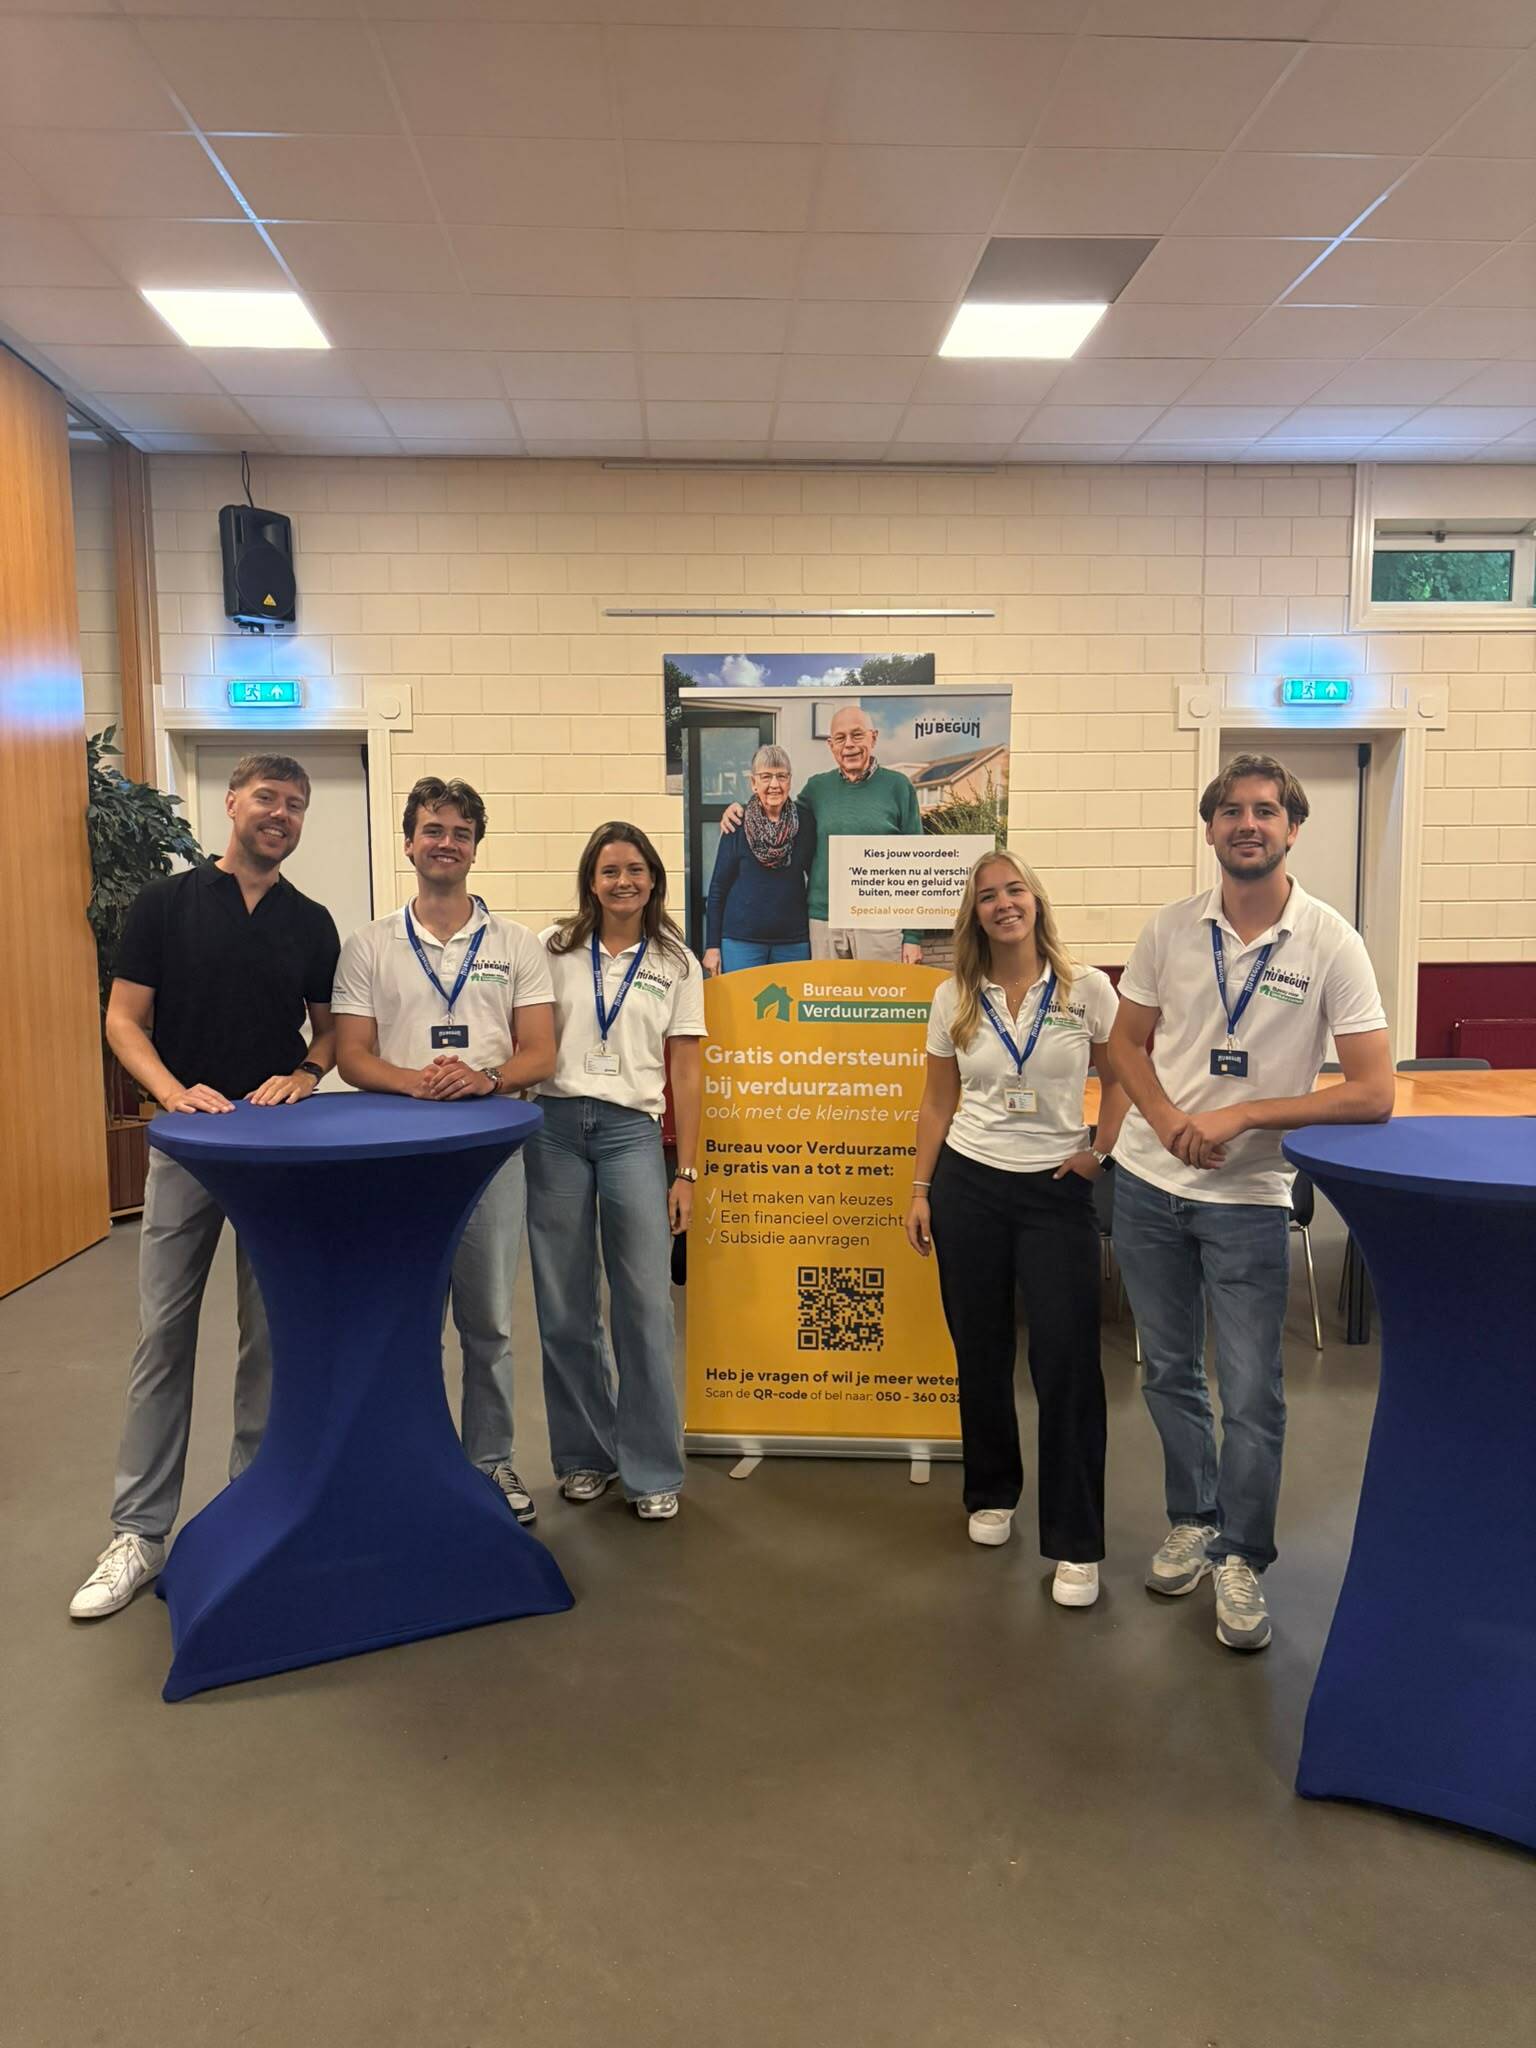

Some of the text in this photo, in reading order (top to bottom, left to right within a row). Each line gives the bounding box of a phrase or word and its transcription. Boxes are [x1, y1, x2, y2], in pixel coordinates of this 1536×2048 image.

[864, 849, 960, 860] Kies jouw voordeel:
[870, 867, 906, 876] merken
[923, 867, 932, 876] al
[851, 878, 885, 886] minder
[887, 878, 905, 886] kou
[922, 878, 952, 888] geluid
[858, 888, 893, 898] buiten,
[850, 906, 891, 916] Speciaal
[803, 983, 906, 998] Bureau voor
[802, 1004, 928, 1019] Verduurzamen
[704, 1045, 927, 1066] Gratis ondersteunin
[705, 1076, 903, 1099] bij verduurzamen
[706, 1104, 920, 1122] ook met de kleinste vra
[706, 1140, 917, 1156] Bureau voor Verduurzame
[704, 1160, 894, 1176] je gratis van a tot z met:
[720, 1190, 894, 1206] Het maken van keuzes
[720, 1210, 904, 1227] Een financieel overzicht
[720, 1230, 870, 1248] Subsidie aanvragen
[706, 1368, 737, 1380] Heb
[740, 1369, 754, 1384] je
[758, 1372, 809, 1384] vragen
[812, 1370, 828, 1382] of
[832, 1371, 853, 1383] wil
[856, 1372, 870, 1386] je
[874, 1374, 913, 1384] meer
[705, 1387, 733, 1398] Scan
[736, 1388, 750, 1398] de
[753, 1388, 808, 1400] QR-code
[810, 1390, 822, 1400] of
[824, 1390, 842, 1400] bel
[876, 1392, 902, 1402] 050
[912, 1392, 936, 1402] 360
